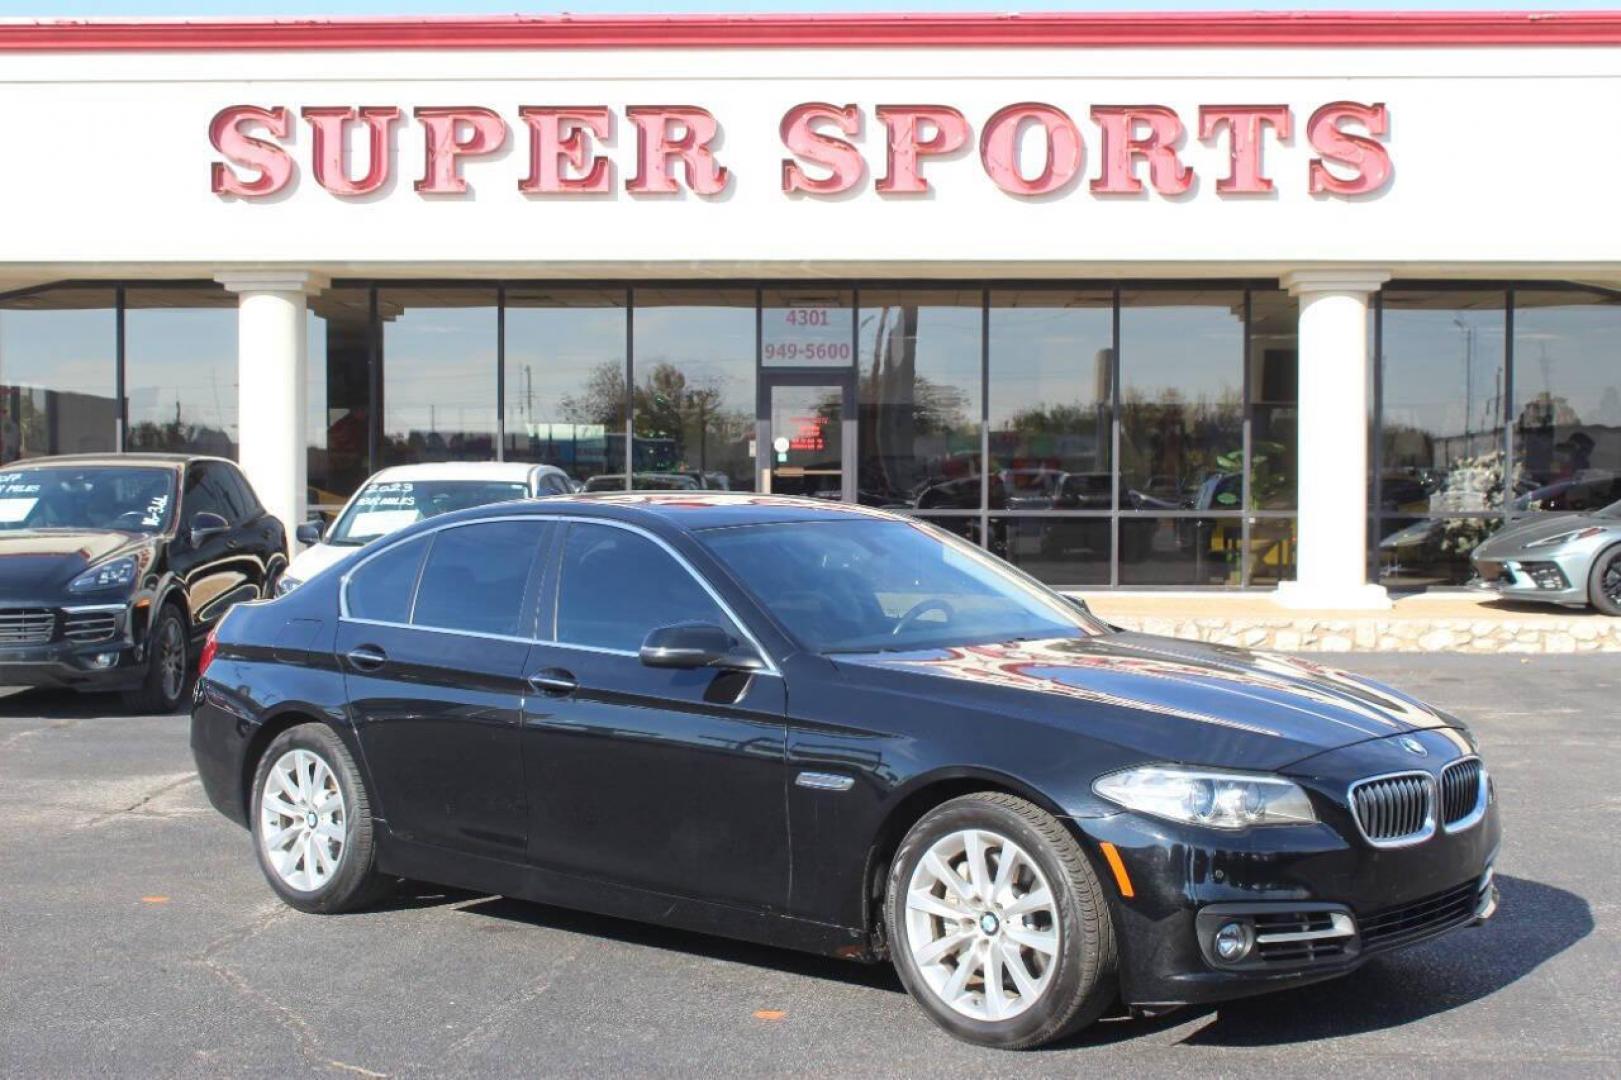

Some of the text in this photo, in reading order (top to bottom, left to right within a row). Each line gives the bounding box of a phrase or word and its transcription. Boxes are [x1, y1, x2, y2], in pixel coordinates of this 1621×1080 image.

[208, 101, 1393, 195] SUPER SPORTS
[785, 309, 830, 326] 4301
[764, 342, 850, 360] 949-5600
